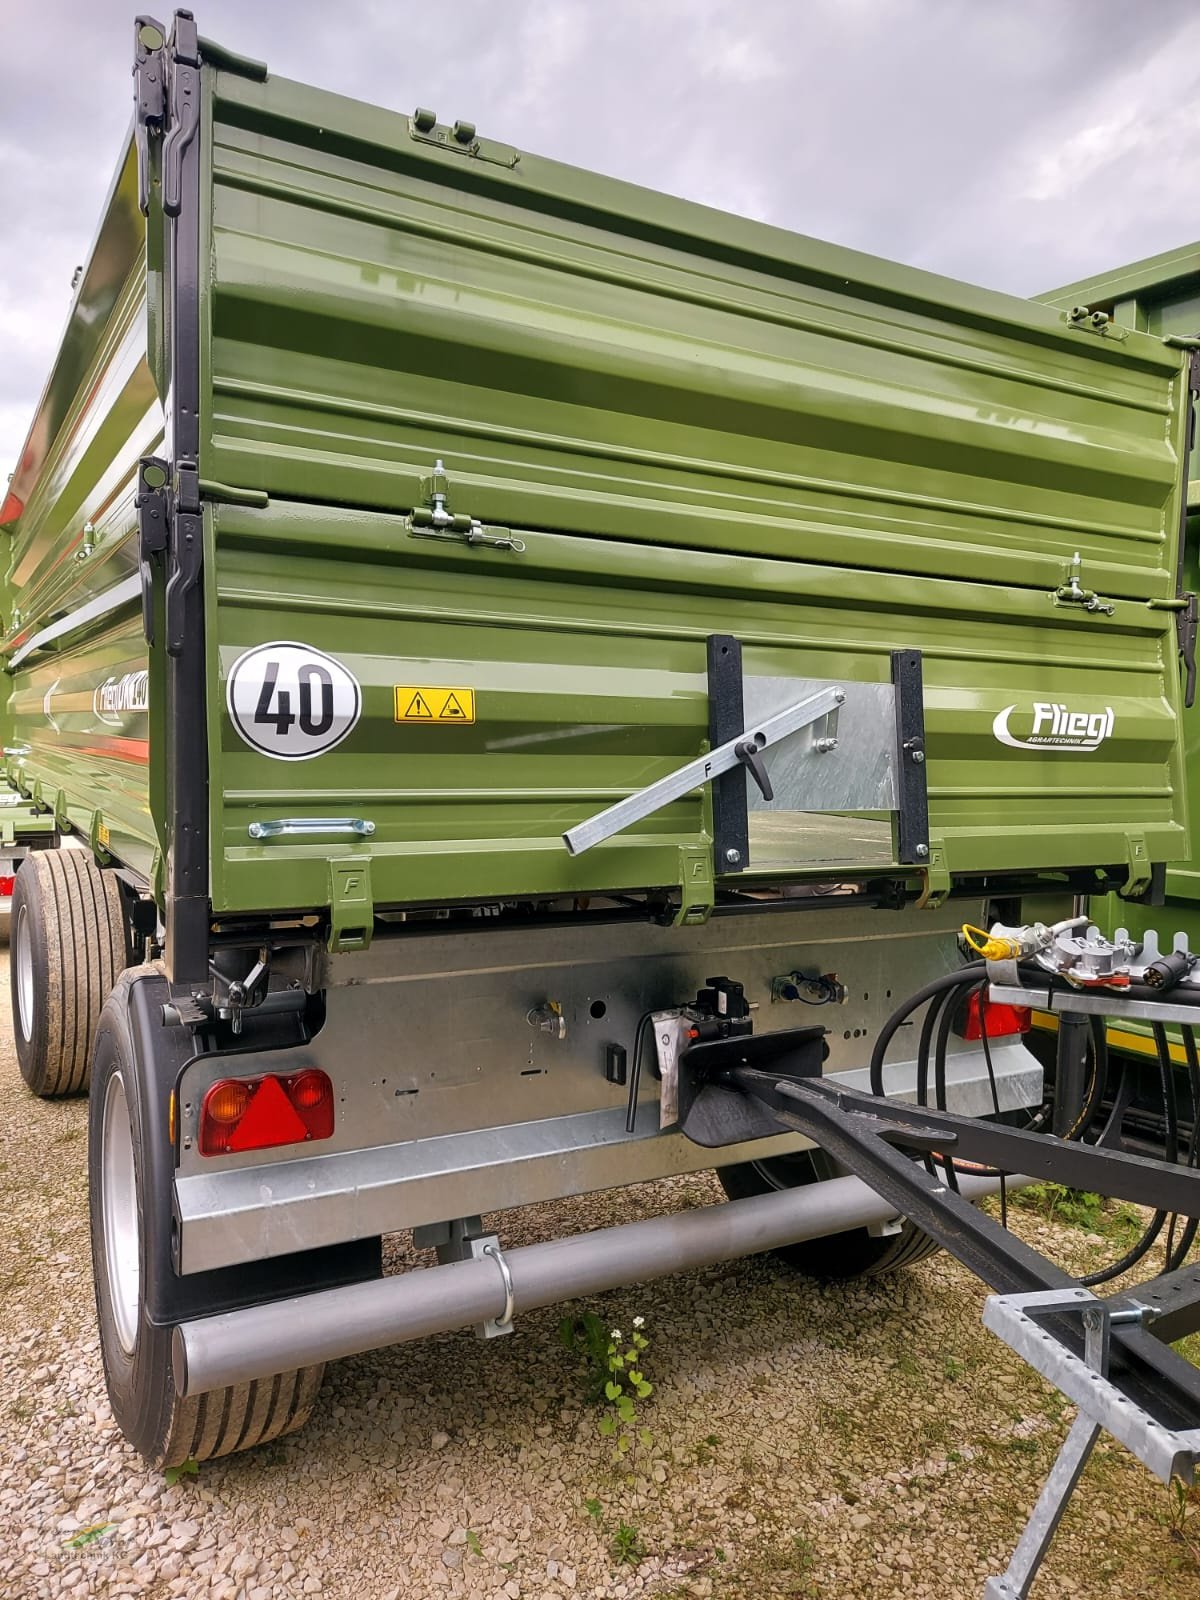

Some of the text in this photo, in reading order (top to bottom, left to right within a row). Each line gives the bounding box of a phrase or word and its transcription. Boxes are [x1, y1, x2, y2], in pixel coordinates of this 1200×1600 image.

[254, 661, 334, 737] 40
[1032, 702, 1115, 745] Fliegl
[704, 762, 712, 778] F
[691, 862, 704, 877] F
[344, 877, 360, 895] F
